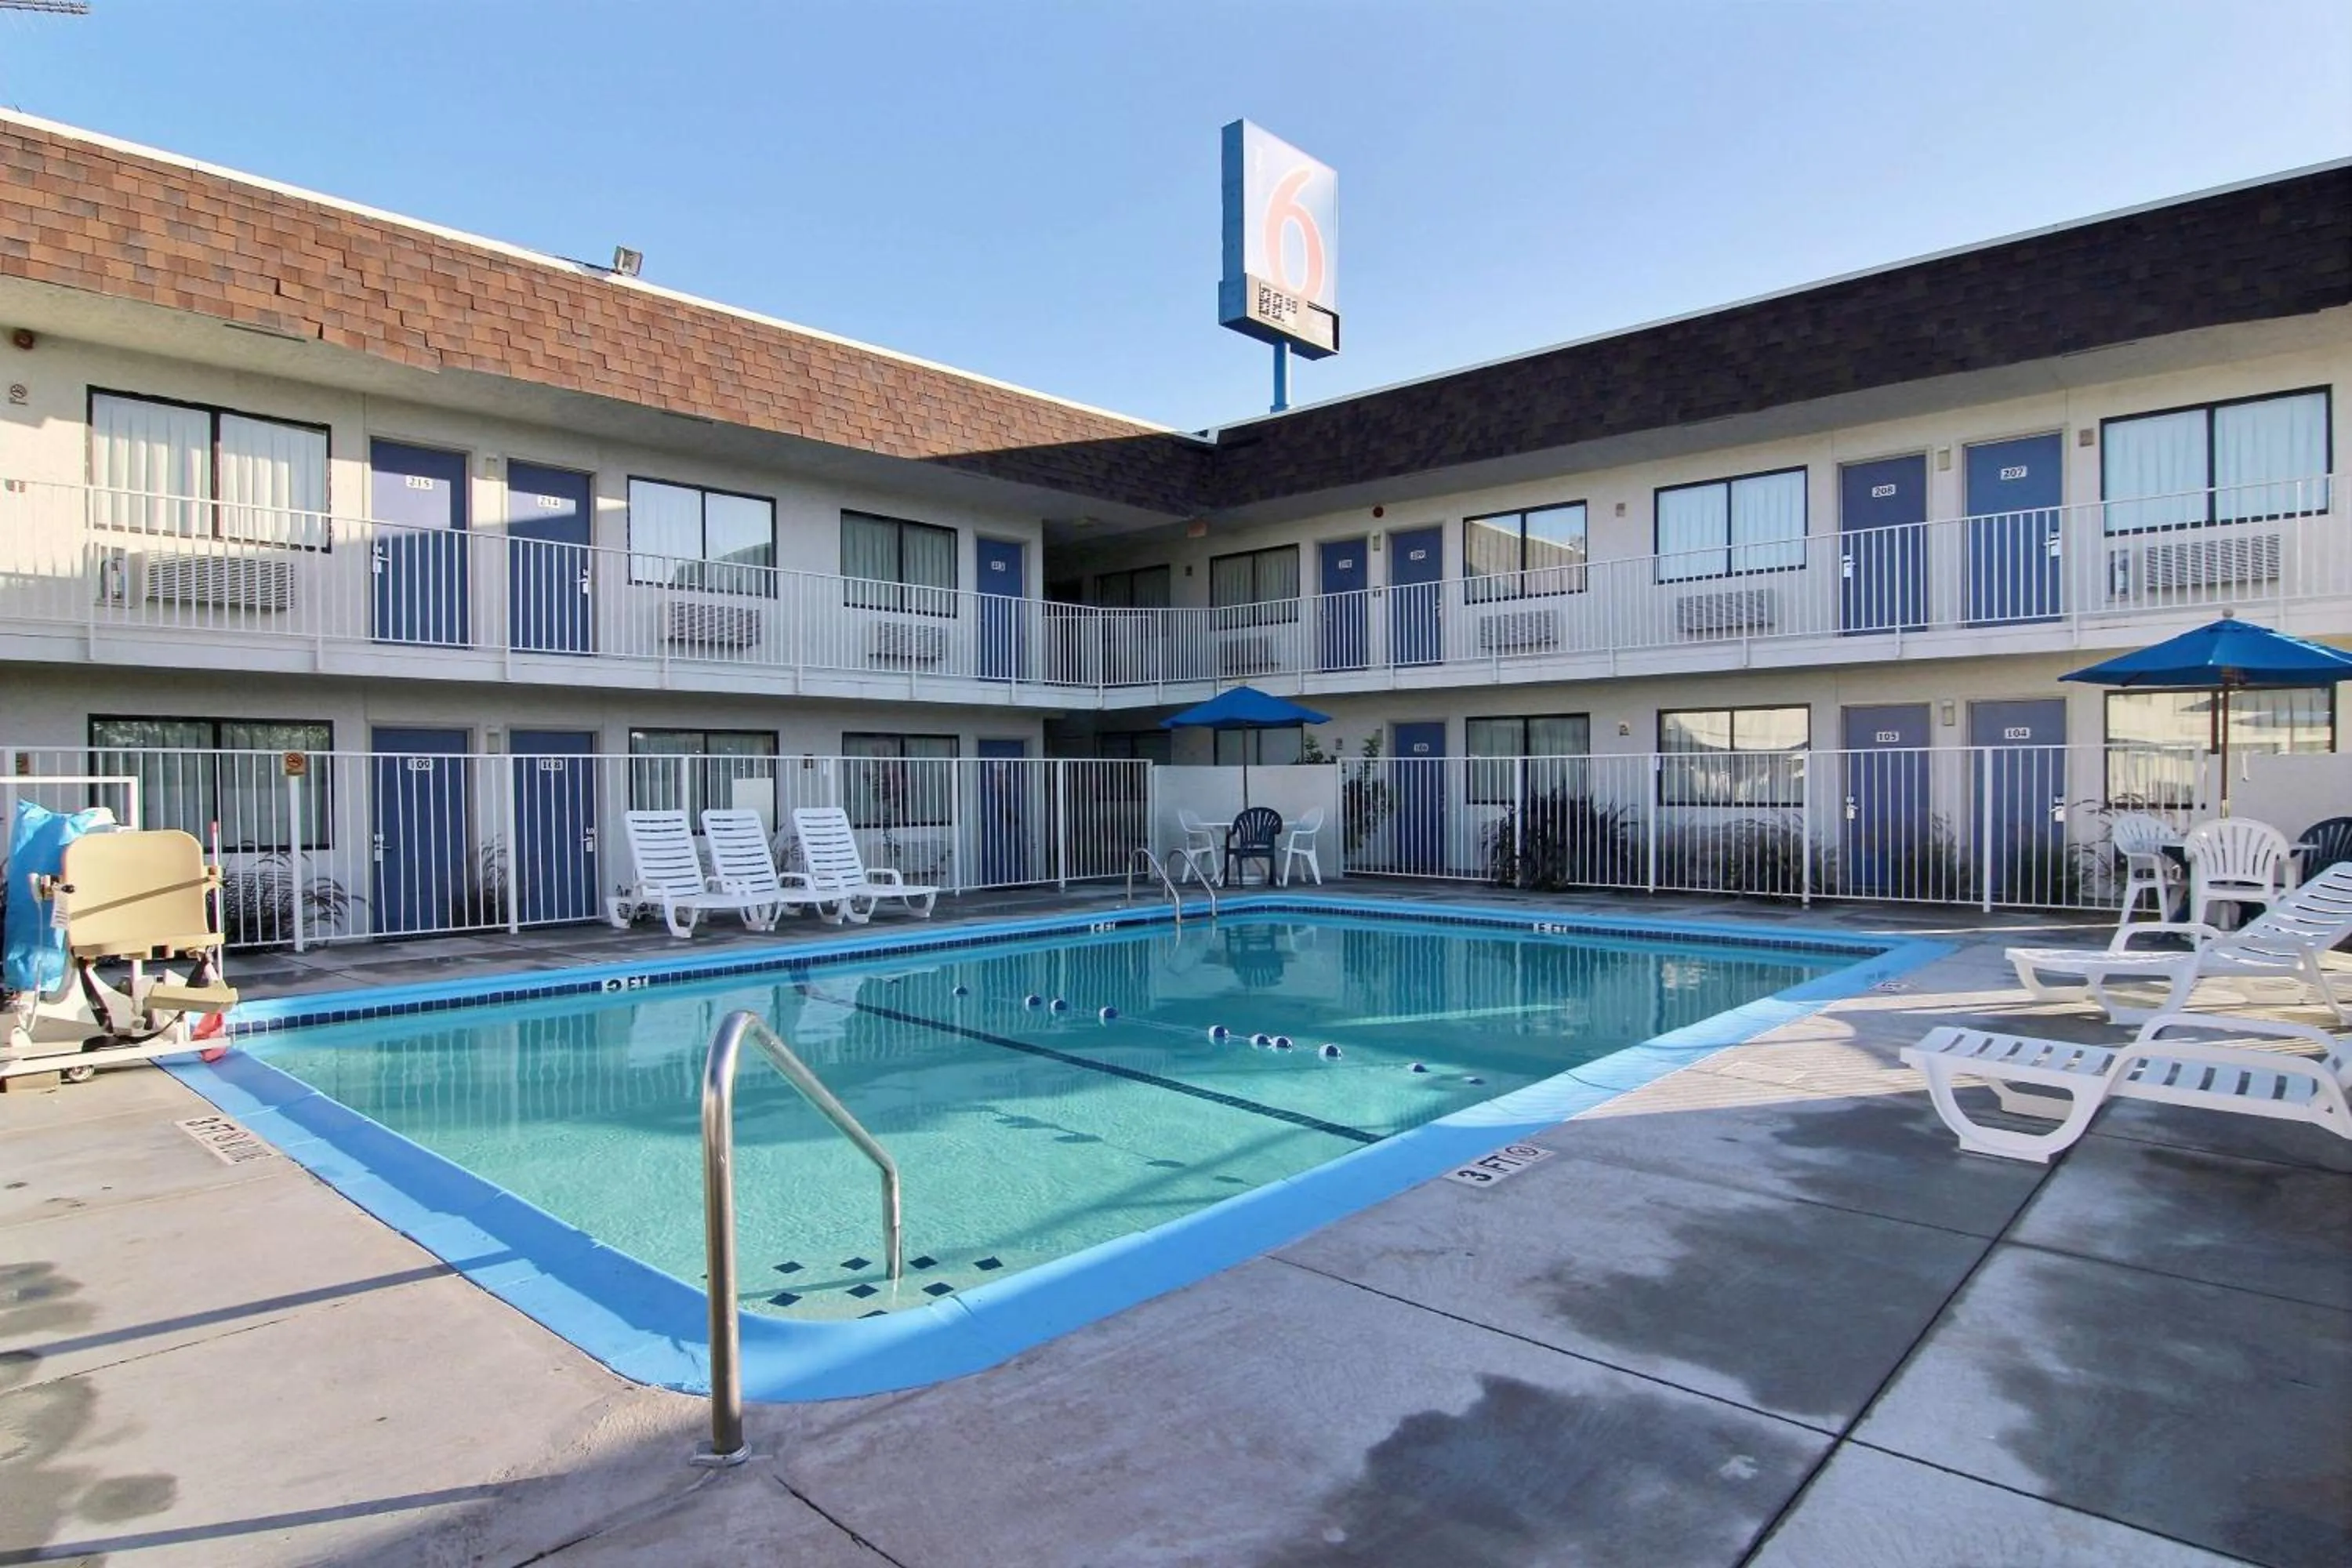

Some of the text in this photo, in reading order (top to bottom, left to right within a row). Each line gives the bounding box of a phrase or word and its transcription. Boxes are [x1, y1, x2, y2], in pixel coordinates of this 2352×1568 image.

[1264, 165, 1325, 303] 6
[2002, 467, 2025, 478] 207
[1878, 732, 1896, 742] 105
[2007, 728, 2027, 738] 104
[1457, 1170, 1493, 1181] 3
[1477, 1155, 1522, 1173] FT
